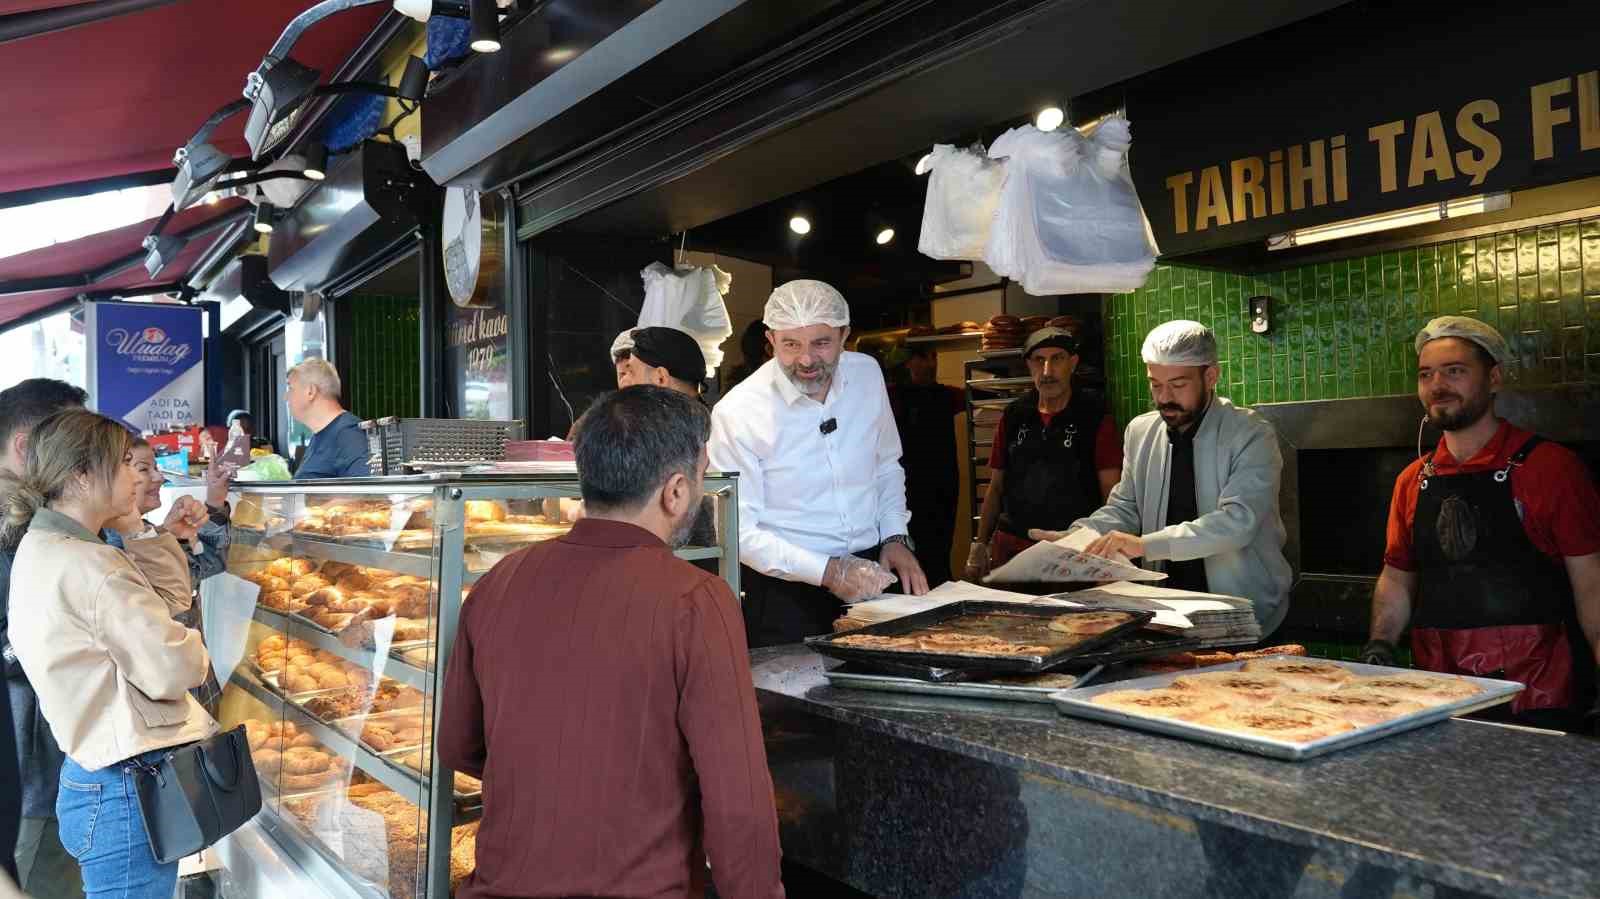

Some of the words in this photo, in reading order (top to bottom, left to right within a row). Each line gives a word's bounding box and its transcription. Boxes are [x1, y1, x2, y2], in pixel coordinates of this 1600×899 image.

[1369, 100, 1502, 193] TAŞ
[173, 399, 190, 407] DA
[176, 410, 193, 419] DA
